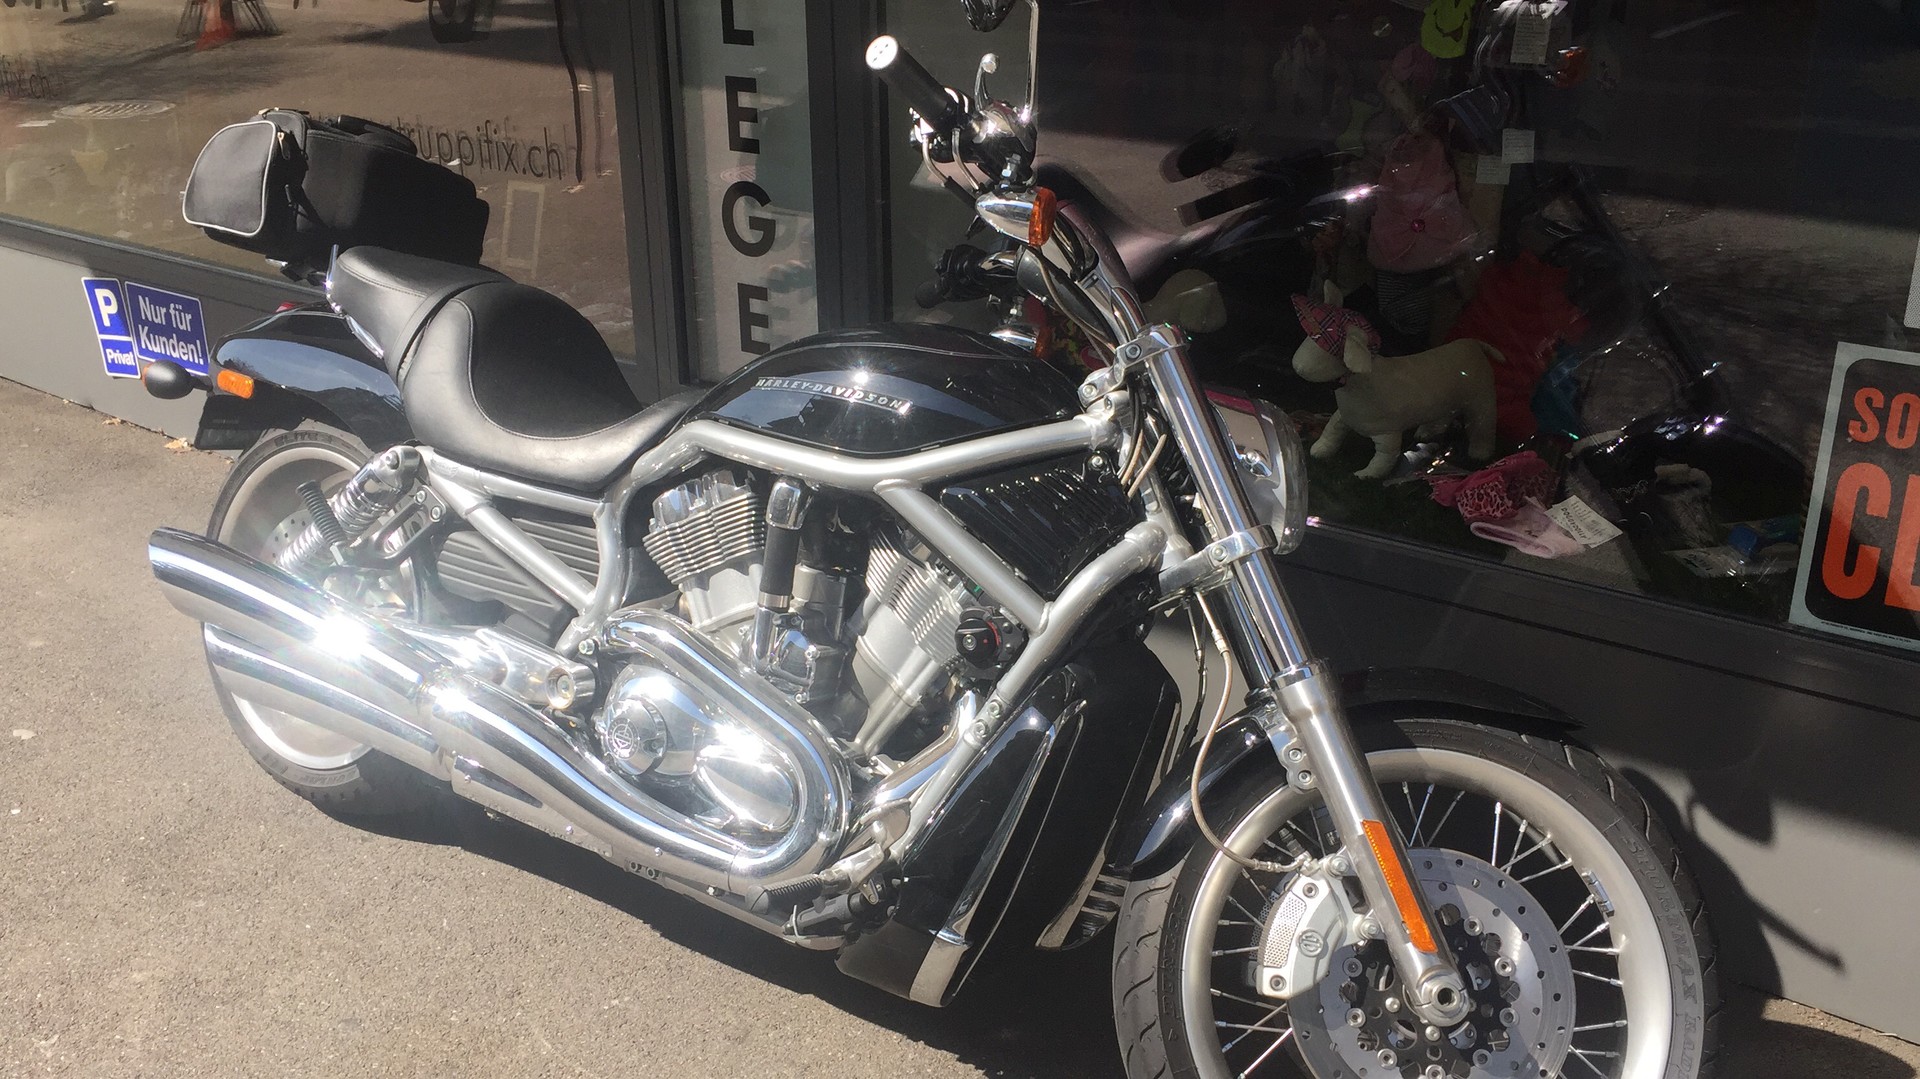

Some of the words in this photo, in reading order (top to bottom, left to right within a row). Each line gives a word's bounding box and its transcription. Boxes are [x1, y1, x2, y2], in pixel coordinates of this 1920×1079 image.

[94, 288, 118, 327] P
[138, 295, 166, 325] Nur
[169, 303, 192, 331] für
[105, 348, 135, 365] Privat
[138, 324, 204, 365] Kunden!
[755, 378, 902, 410] HARLEY-DAVIDSON
